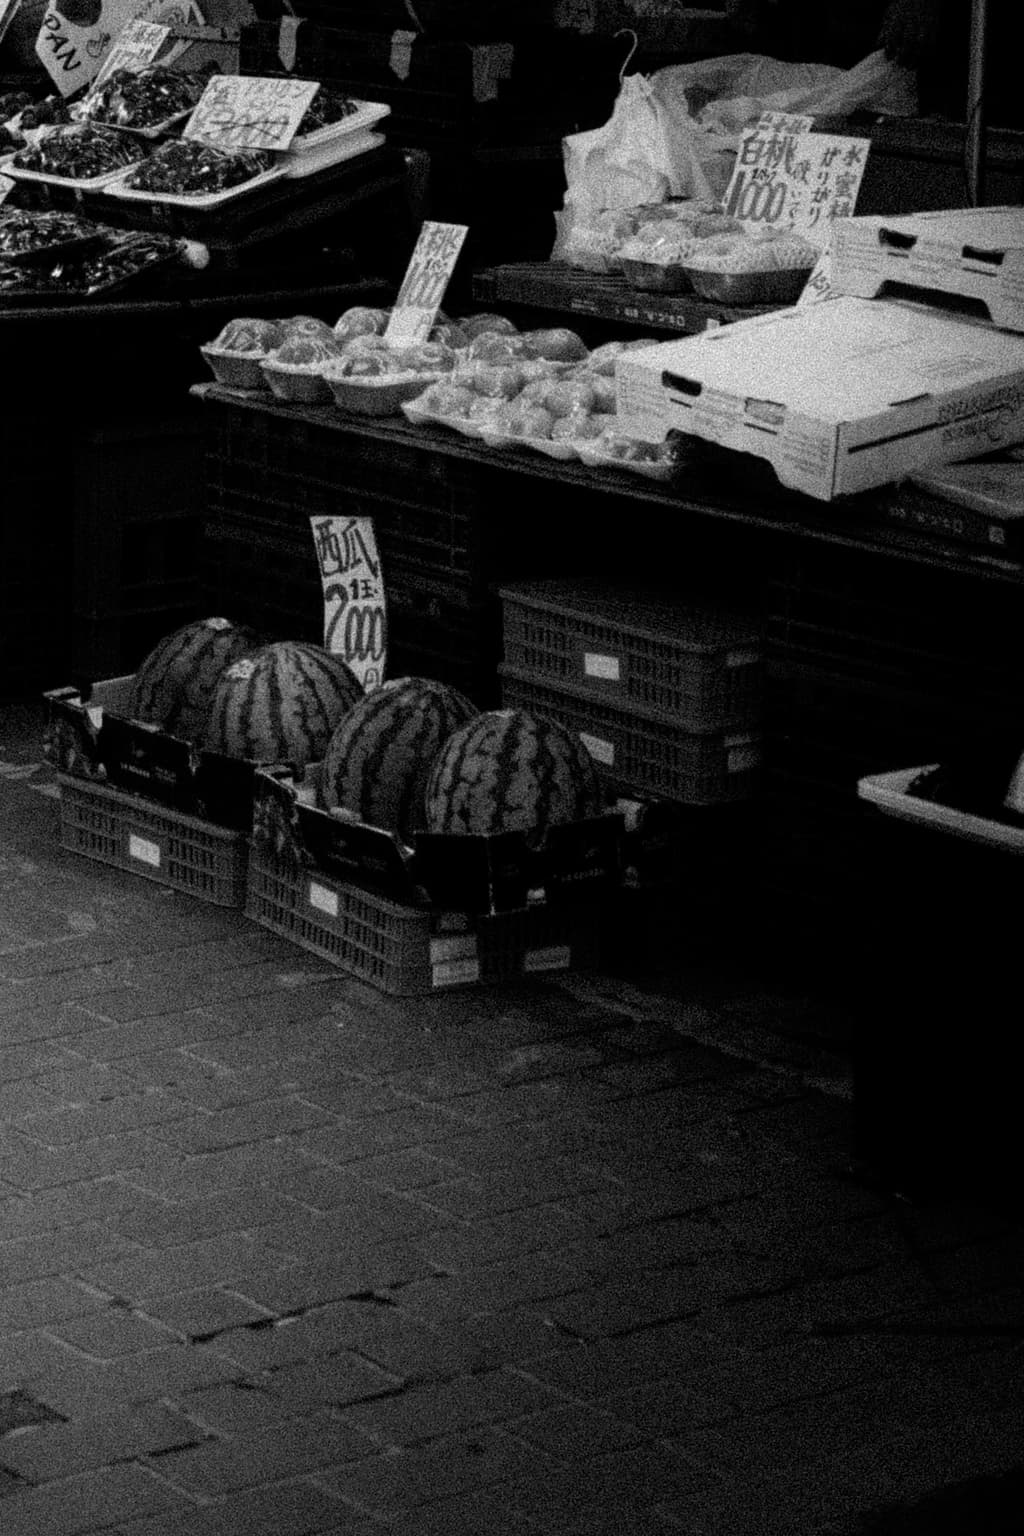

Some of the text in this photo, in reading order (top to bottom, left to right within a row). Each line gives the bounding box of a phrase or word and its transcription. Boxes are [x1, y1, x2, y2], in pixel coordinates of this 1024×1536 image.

[740, 132, 798, 175] 白桃
[727, 169, 787, 223] 1000
[315, 518, 379, 579] 西瓜
[324, 582, 387, 662] 2000
